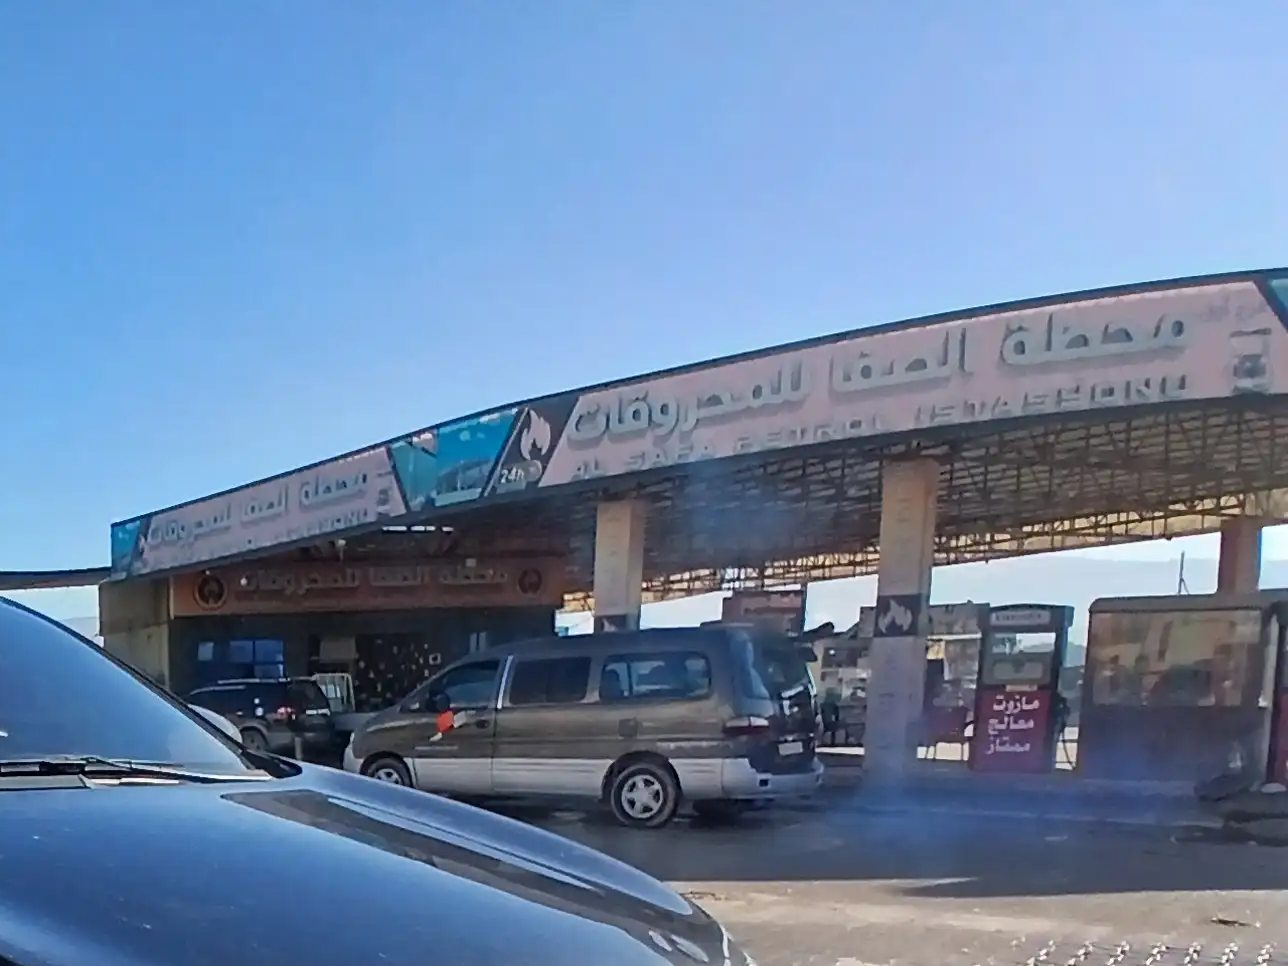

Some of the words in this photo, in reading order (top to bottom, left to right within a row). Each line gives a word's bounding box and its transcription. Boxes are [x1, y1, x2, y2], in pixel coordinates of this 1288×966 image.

[1000, 310, 1190, 367] محطة
[828, 326, 972, 395] الصفا
[566, 358, 811, 441] للمحروقات
[992, 694, 1041, 714] مازوت
[987, 715, 1035, 735] معالج
[986, 735, 1031, 755] ممتاز
